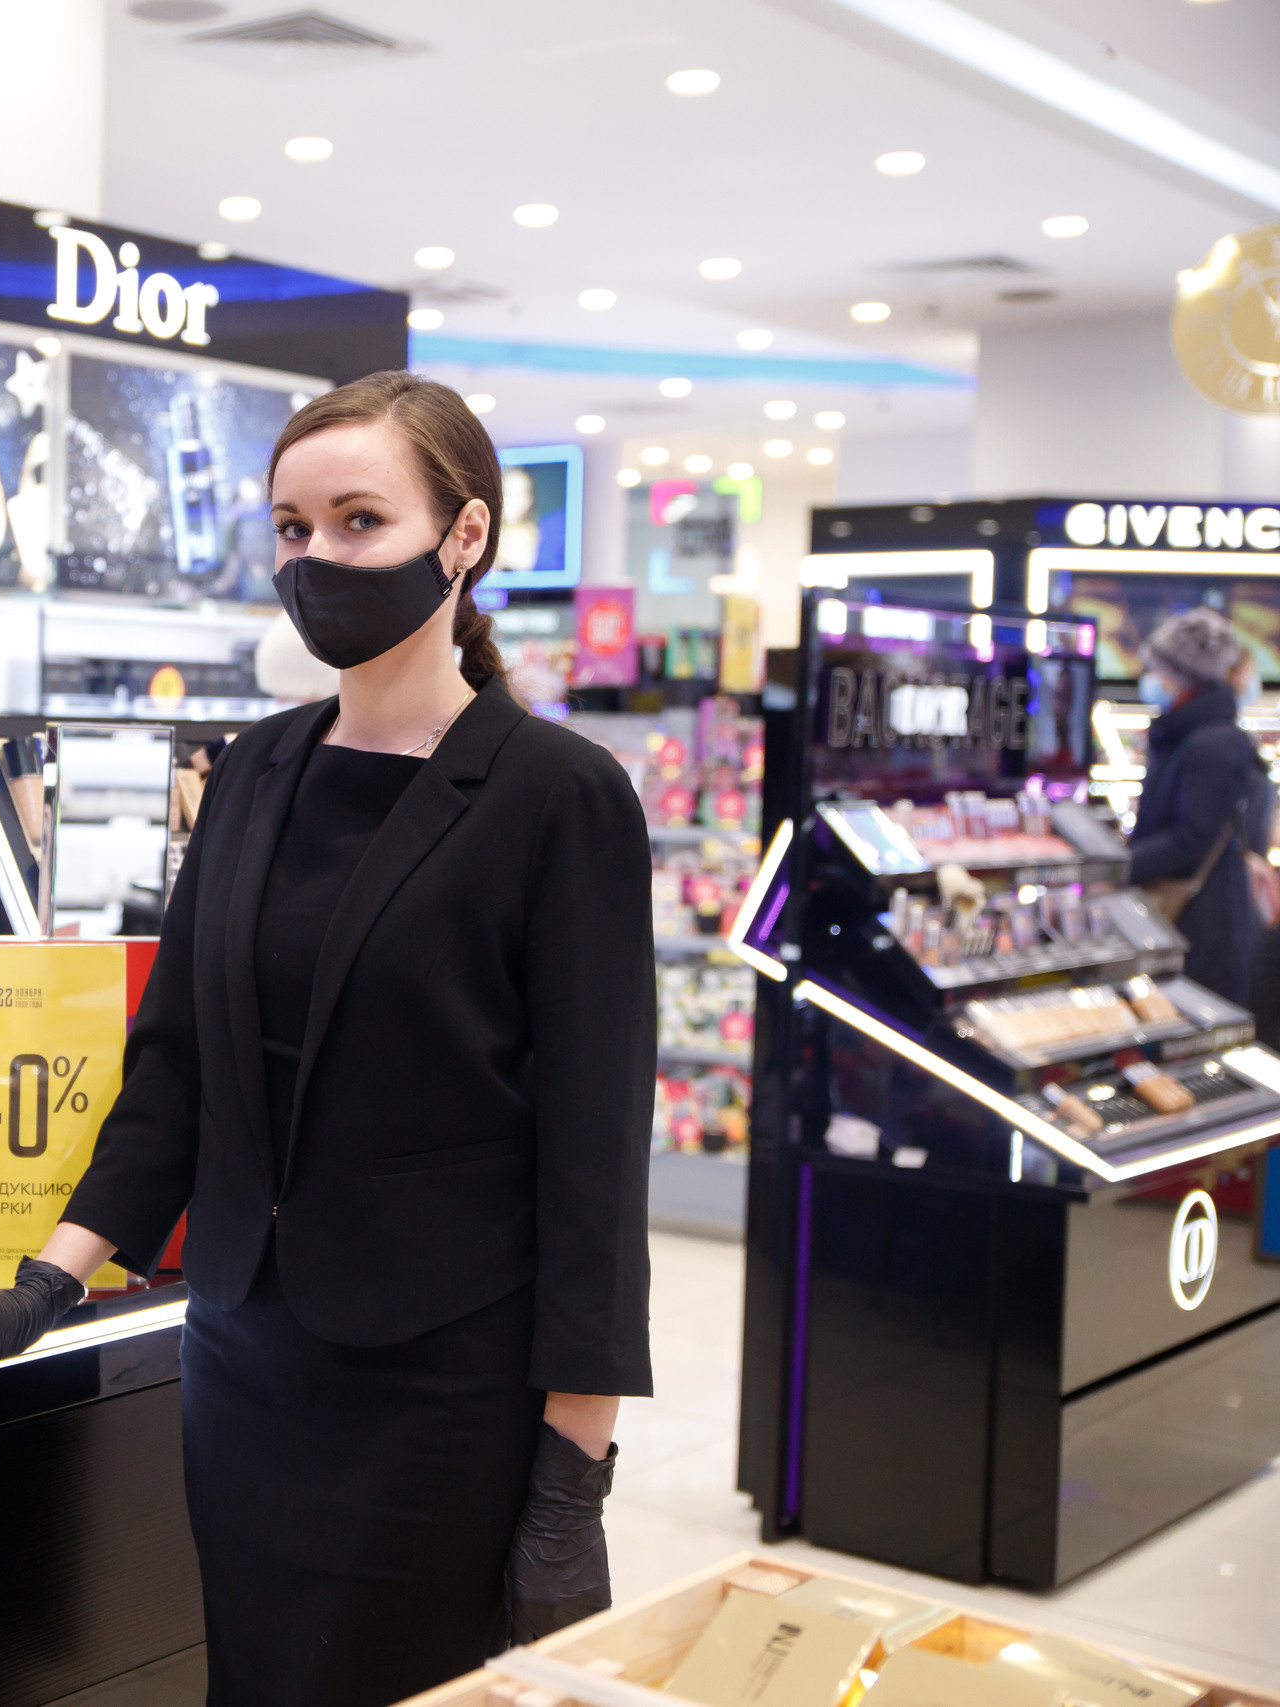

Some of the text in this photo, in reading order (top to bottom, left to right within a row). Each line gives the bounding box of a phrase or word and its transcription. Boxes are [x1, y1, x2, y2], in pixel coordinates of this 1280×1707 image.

[46, 225, 219, 345] Dior
[1065, 502, 1280, 550] GIVENC
[15, 988, 42, 997] НОЯБРЯ
